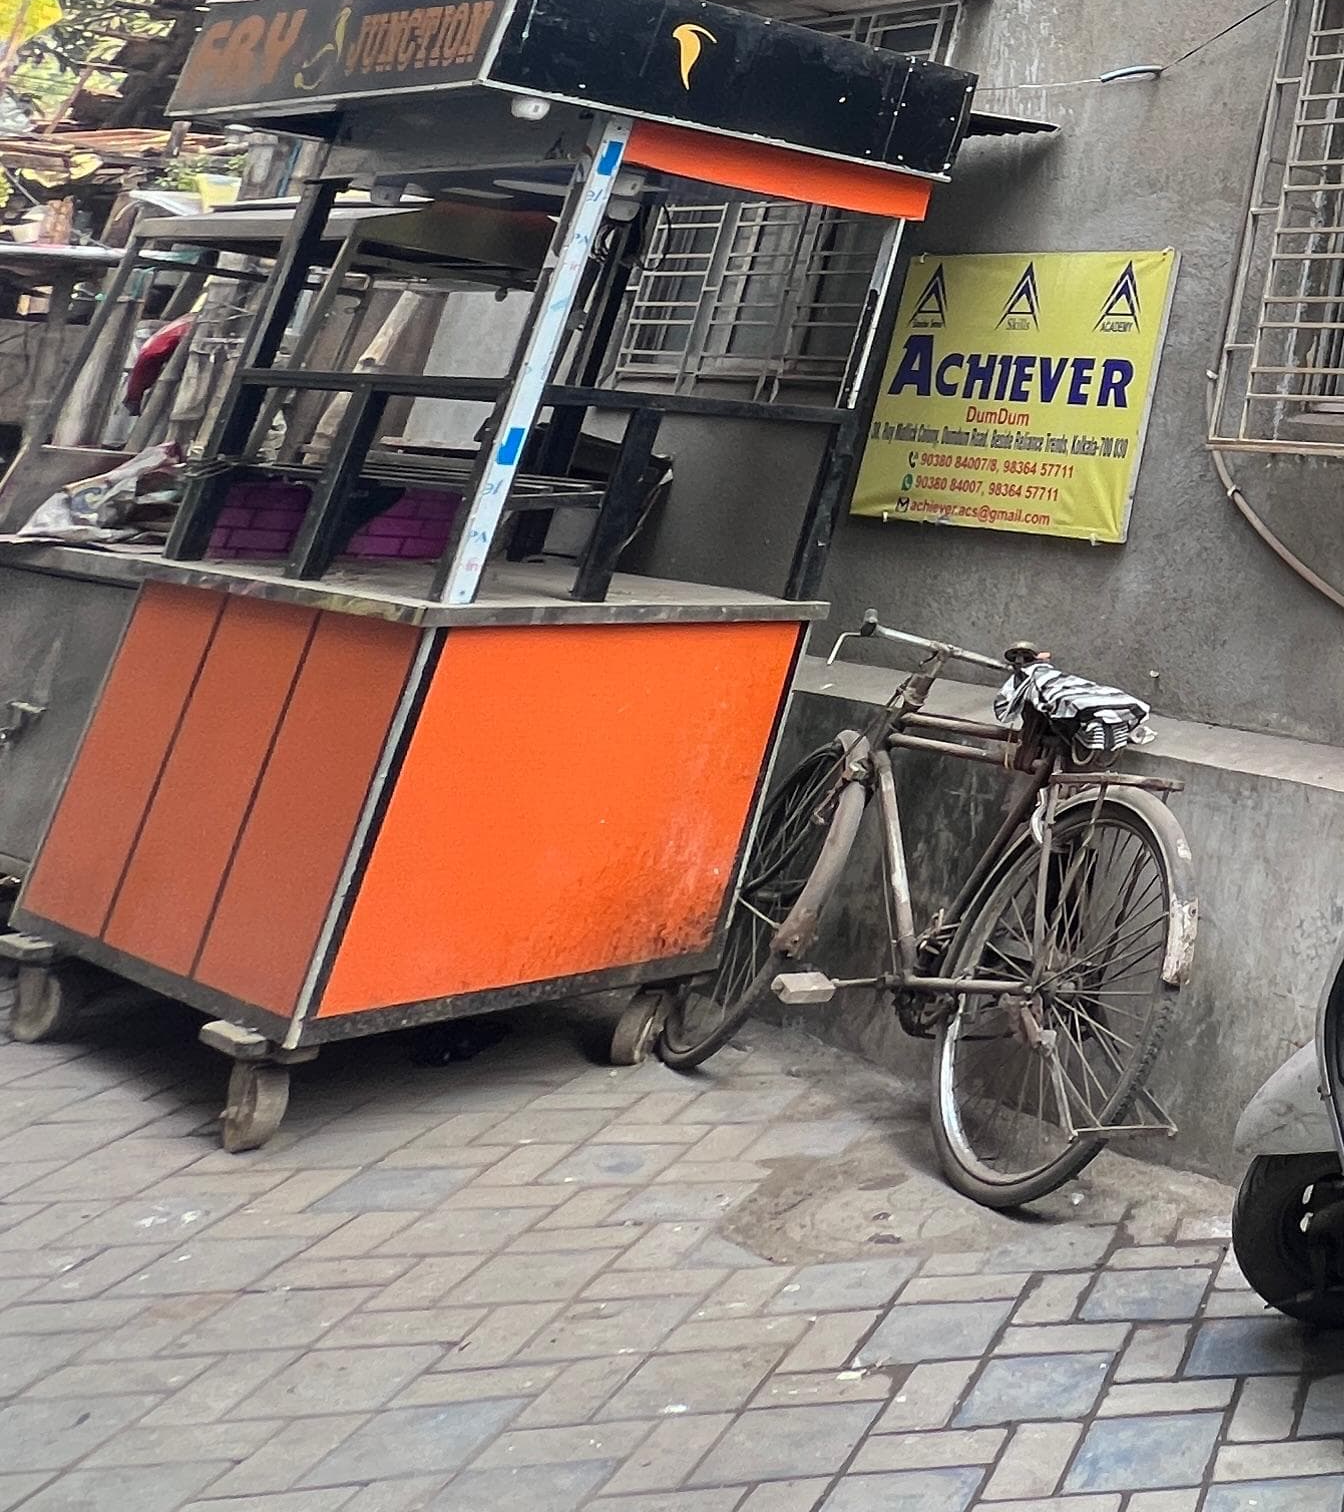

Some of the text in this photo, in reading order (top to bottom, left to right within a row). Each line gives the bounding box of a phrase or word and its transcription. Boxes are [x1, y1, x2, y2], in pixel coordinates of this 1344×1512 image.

[344, 0, 496, 76] JUNCTION
[1101, 321, 1134, 333] ACADEMY
[887, 334, 1134, 408] ACHIEVER
[965, 406, 1030, 426] DumDum
[920, 452, 953, 467] 90380
[1003, 460, 1037, 475] 98364
[1040, 463, 1074, 479] 57711
[988, 482, 1021, 497] 98364
[1025, 485, 1058, 501] 57711
[909, 497, 1051, 527] achiever.acs@gmail.com
